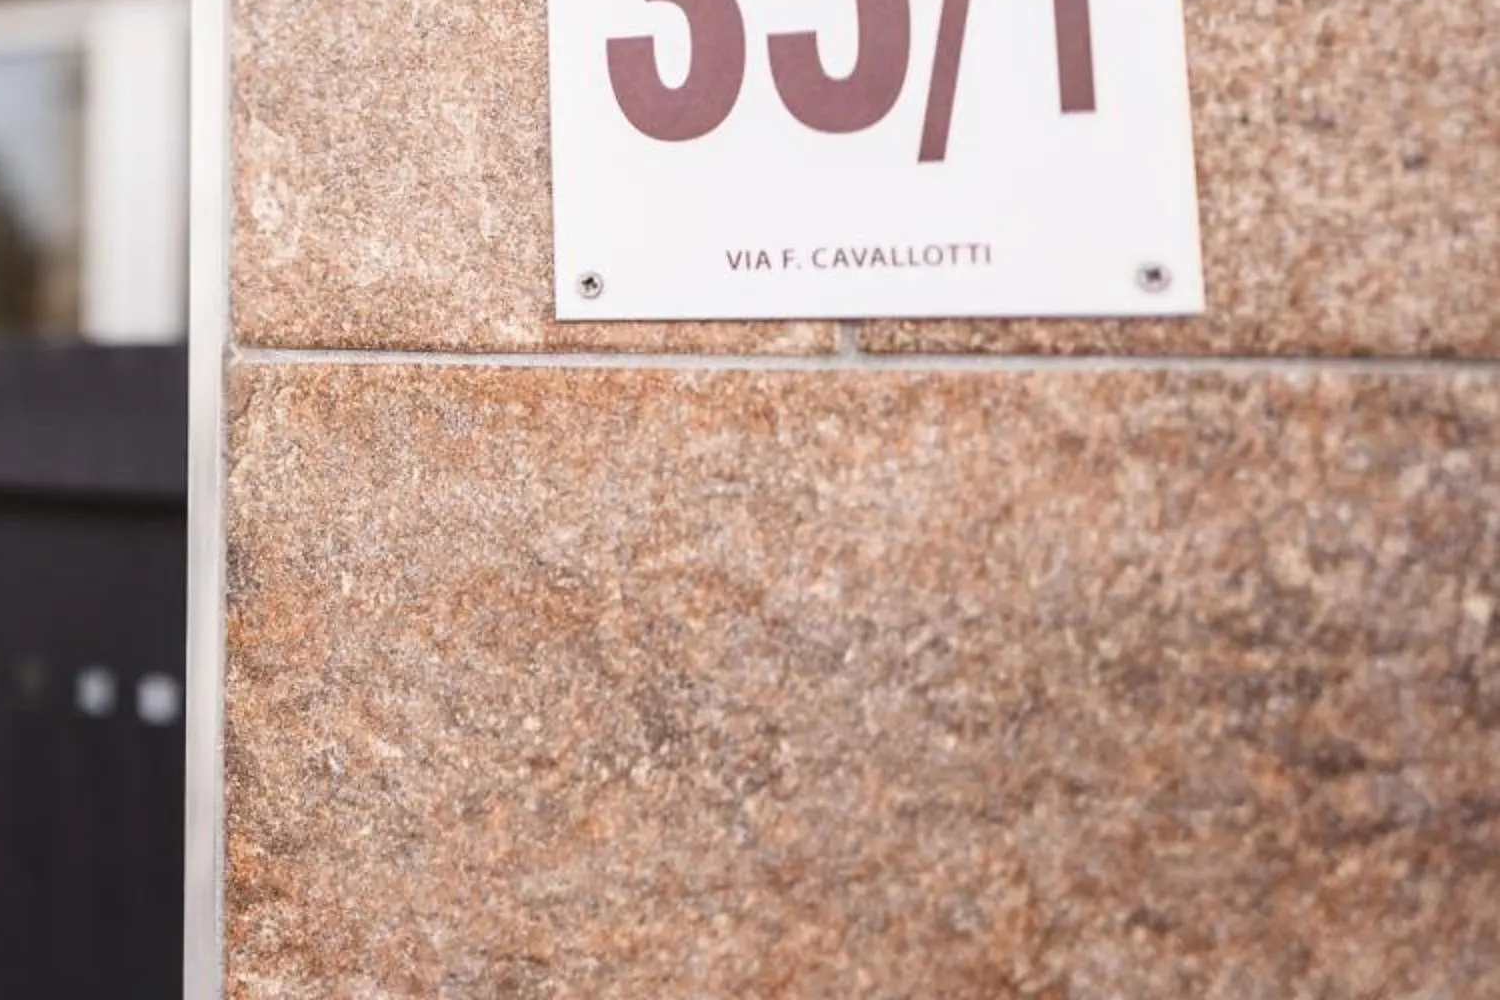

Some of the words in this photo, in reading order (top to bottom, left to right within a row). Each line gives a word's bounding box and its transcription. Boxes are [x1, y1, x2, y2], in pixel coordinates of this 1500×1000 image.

[725, 249, 772, 271] VIA
[782, 248, 802, 270] F.
[810, 243, 992, 269] CAVALLOTTI
